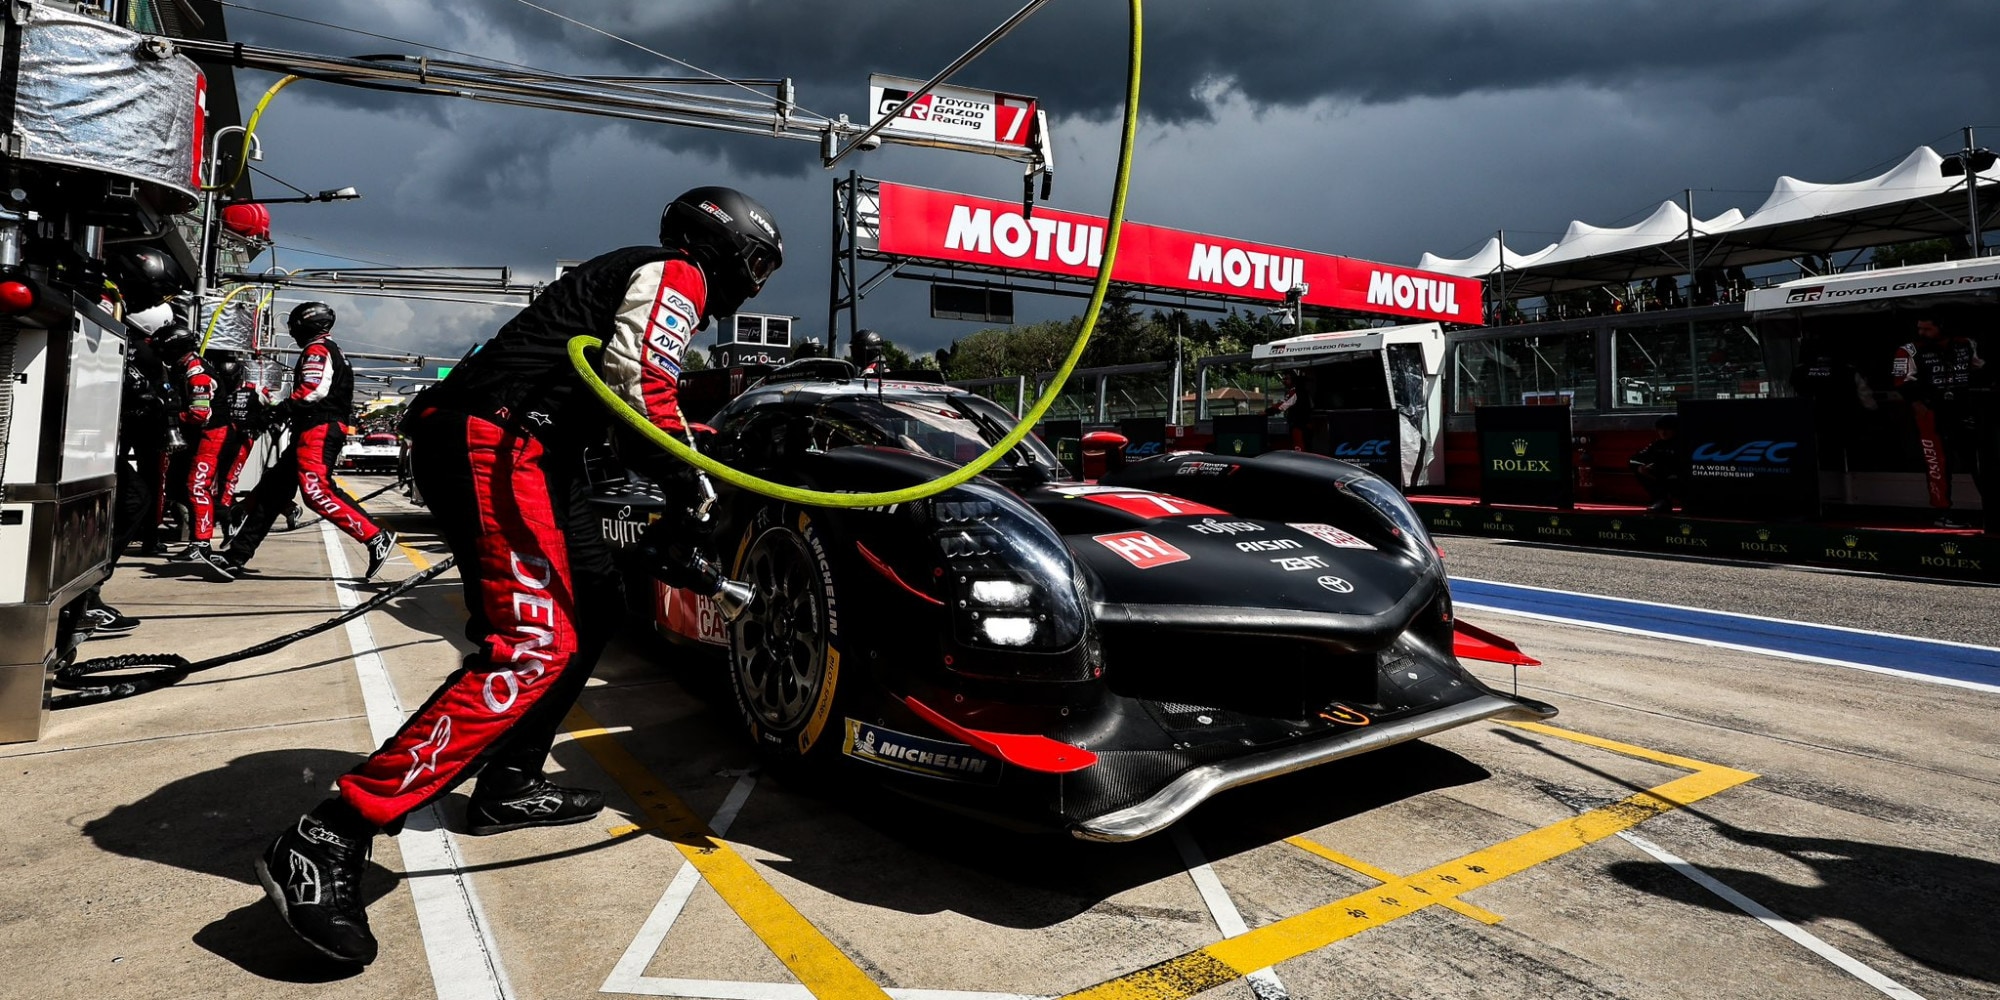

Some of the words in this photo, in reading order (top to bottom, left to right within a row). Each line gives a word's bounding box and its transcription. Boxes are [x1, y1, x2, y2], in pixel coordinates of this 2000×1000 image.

[878, 100, 929, 120] GR
[933, 105, 984, 119] GAZOO
[936, 96, 990, 111] TOYOTA
[932, 114, 981, 130] Racing
[1003, 98, 1028, 142] 7
[749, 210, 776, 238] uvex
[944, 205, 1104, 268] MOTUL
[1188, 243, 1305, 293] MOTUL
[1367, 270, 1460, 315] MOTUL
[1788, 291, 1821, 303] GR
[1826, 286, 1888, 298] TOYOTA
[1892, 279, 1954, 291] GAZOO
[1958, 273, 2000, 284] Raci
[654, 334, 683, 357] ADVI
[739, 353, 786, 364] IMOLA
[1334, 439, 1391, 456] WEC
[1691, 440, 1798, 463] WEC
[1493, 459, 1552, 473] ROLEX
[1921, 439, 1941, 480] DENSO
[1227, 463, 1241, 477] 7
[1692, 470, 1755, 478] CHAMPIONSHIP
[1738, 466, 1791, 474] ENDURANCE
[305, 471, 341, 514] DENSO
[602, 506, 647, 549] FUJITS
[1187, 518, 1265, 535] FUJITSU
[1433, 518, 1463, 528] ROLEX
[1483, 522, 1515, 532] ROLEX
[1537, 526, 1573, 537] ROLEX
[1598, 530, 1636, 541] ROLEX
[1665, 535, 1708, 547] ROLEX
[1105, 535, 1171, 561] HY
[1236, 539, 1303, 552] AISIN
[1741, 542, 1788, 553] ROLEX
[1270, 556, 1330, 571] ZENT
[1825, 549, 1879, 561] ROLEX
[1920, 555, 1982, 570] ROLEX
[811, 537, 838, 636] MICHELIN
[482, 551, 555, 713] DENSO
[826, 655, 835, 687] PILOT
[880, 741, 987, 773] MICHELIN
